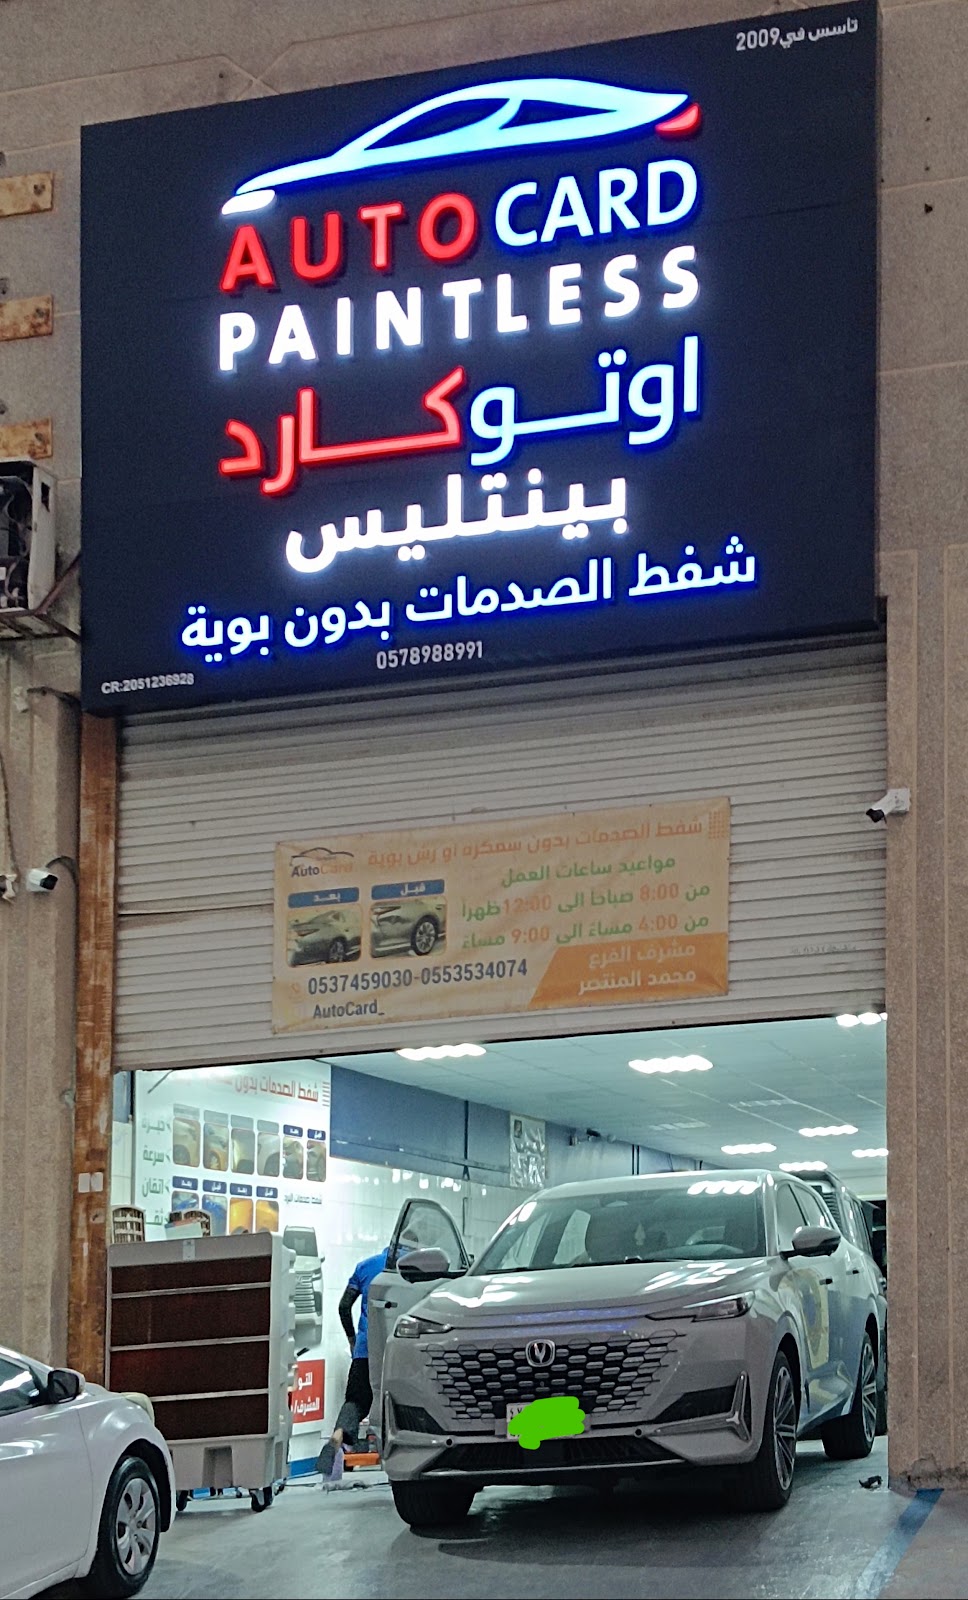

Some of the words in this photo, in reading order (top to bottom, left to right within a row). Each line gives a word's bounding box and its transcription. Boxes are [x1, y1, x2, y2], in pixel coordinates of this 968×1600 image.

[219, 192, 478, 291] AUTO
[493, 158, 699, 247] CARD
[218, 245, 700, 371] PAINTLESS
[469, 335, 699, 466] اوتو
[218, 366, 466, 494] كارد
[285, 466, 629, 572] بينتليس
[628, 535, 756, 596] شفط
[404, 557, 612, 624] الصدمات
[181, 605, 271, 662] بوية
[283, 598, 391, 648] بدون
[376, 640, 483, 670] 0578988991
[575, 822, 650, 846] الصدمات
[656, 815, 702, 837] شفط
[528, 834, 570, 853] بدون
[501, 865, 550, 888] العمل
[556, 860, 612, 879] ساعات
[619, 855, 676, 875] مواعيد
[639, 882, 680, 902] 8:00
[685, 884, 710, 901] من
[638, 913, 679, 932] 4:00
[684, 914, 710, 933] من
[511, 926, 550, 944] 9:00
[589, 945, 631, 970] الفرع
[636, 940, 696, 963] مشرف
[647, 969, 697, 986] محمد
